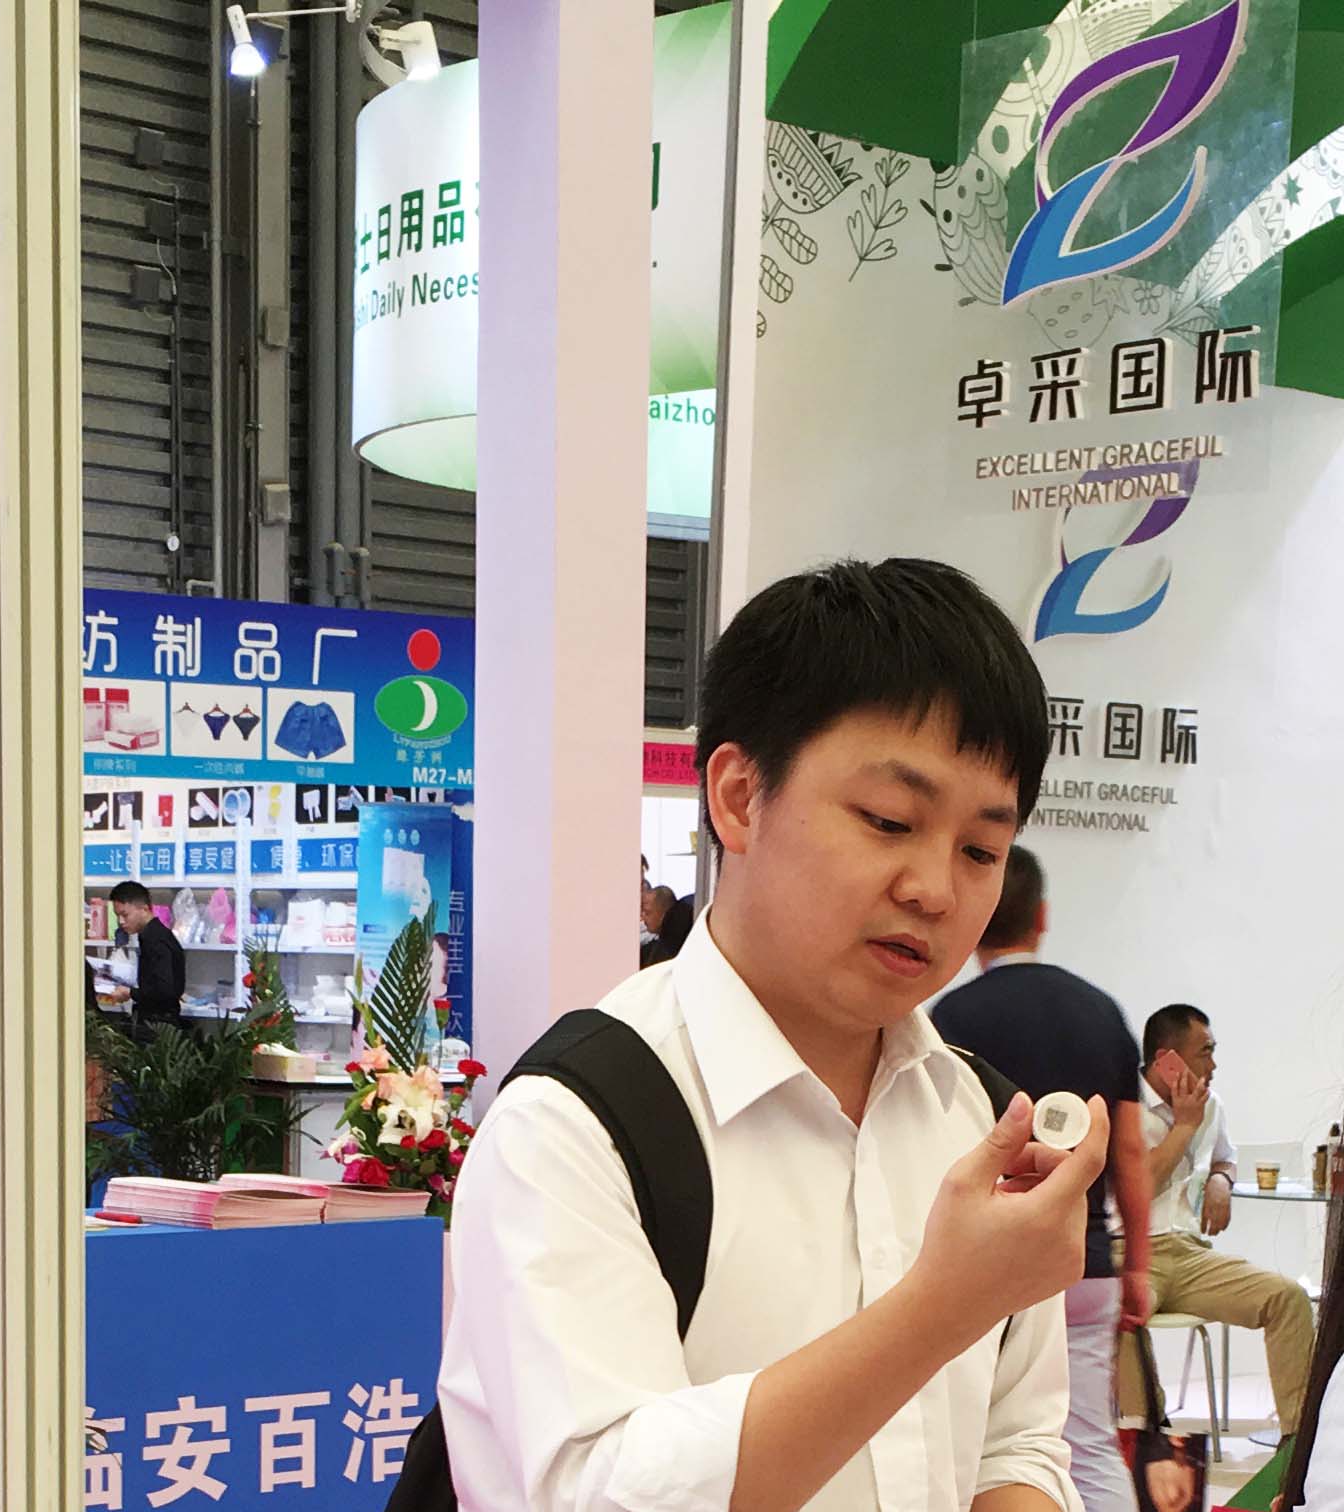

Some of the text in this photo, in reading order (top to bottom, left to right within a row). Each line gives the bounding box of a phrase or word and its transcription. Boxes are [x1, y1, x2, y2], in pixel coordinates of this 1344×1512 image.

[371, 280, 404, 321] Daily
[411, 272, 479, 307] Neces
[957, 325, 1259, 429] 卓采国际
[975, 435, 1224, 480] EXCELLENT GRACEFUL
[1012, 473, 1180, 512] INTERNATIONAL
[1047, 696, 1198, 765] 采国际
[412, 766, 475, 785] M27-M
[1097, 783, 1179, 805] GRACEFUL
[1030, 807, 1151, 832] INTERNATIONAL
